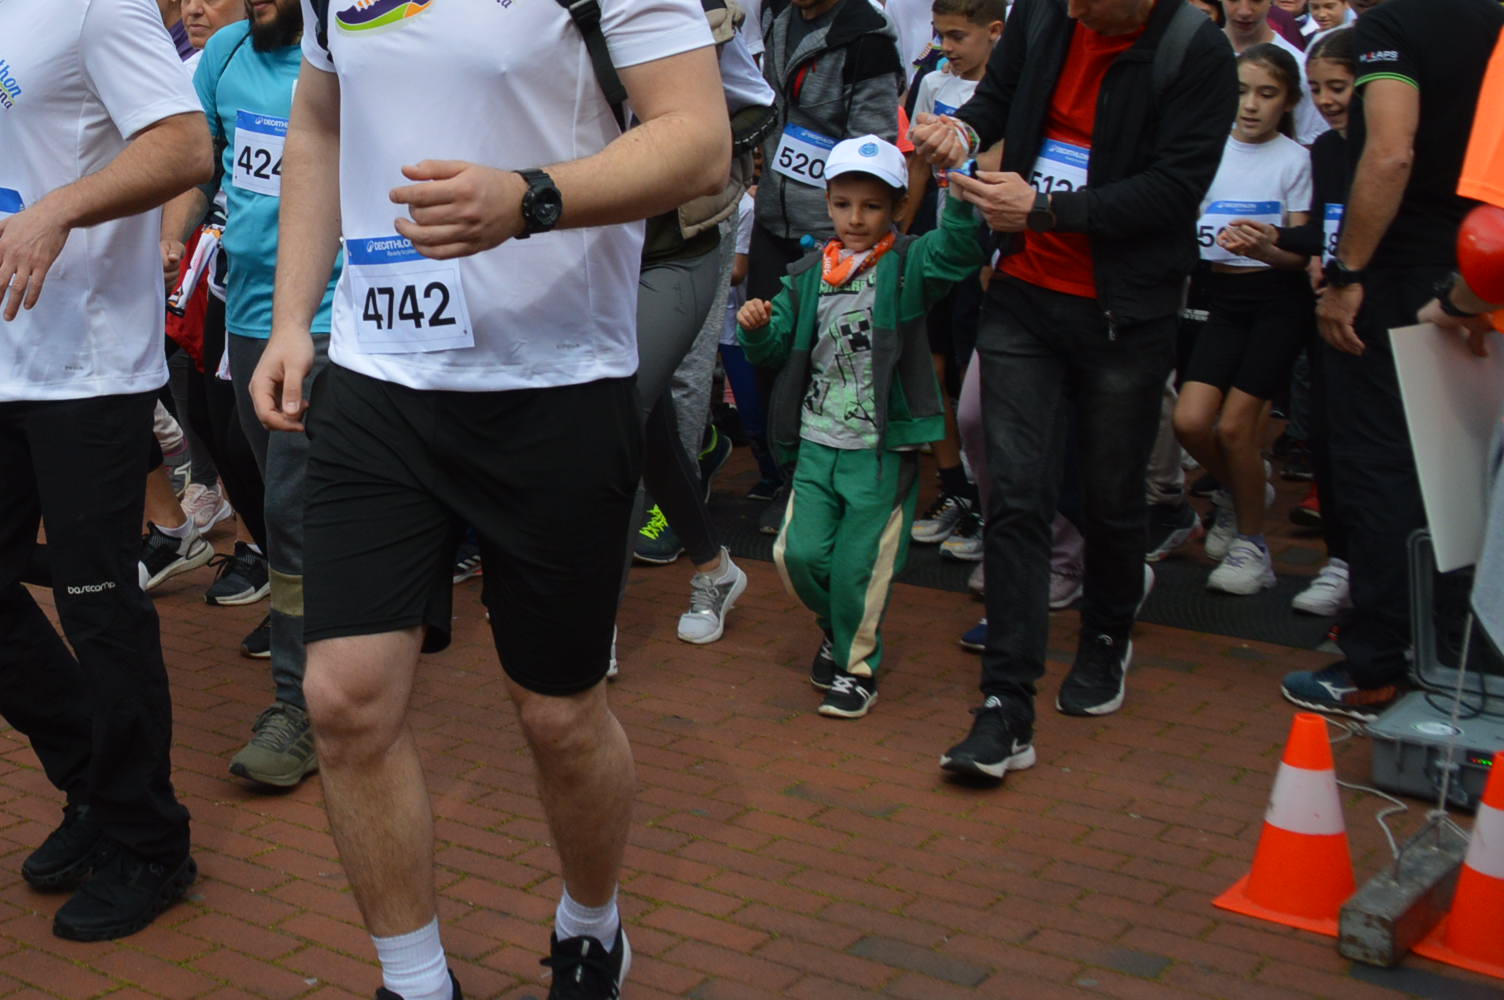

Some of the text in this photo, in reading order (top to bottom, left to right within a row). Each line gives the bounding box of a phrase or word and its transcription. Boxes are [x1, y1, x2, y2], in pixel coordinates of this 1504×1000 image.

[375, 239, 413, 251] DECATHLO
[363, 281, 456, 330] 4742
[67, 581, 116, 594] basecamp
